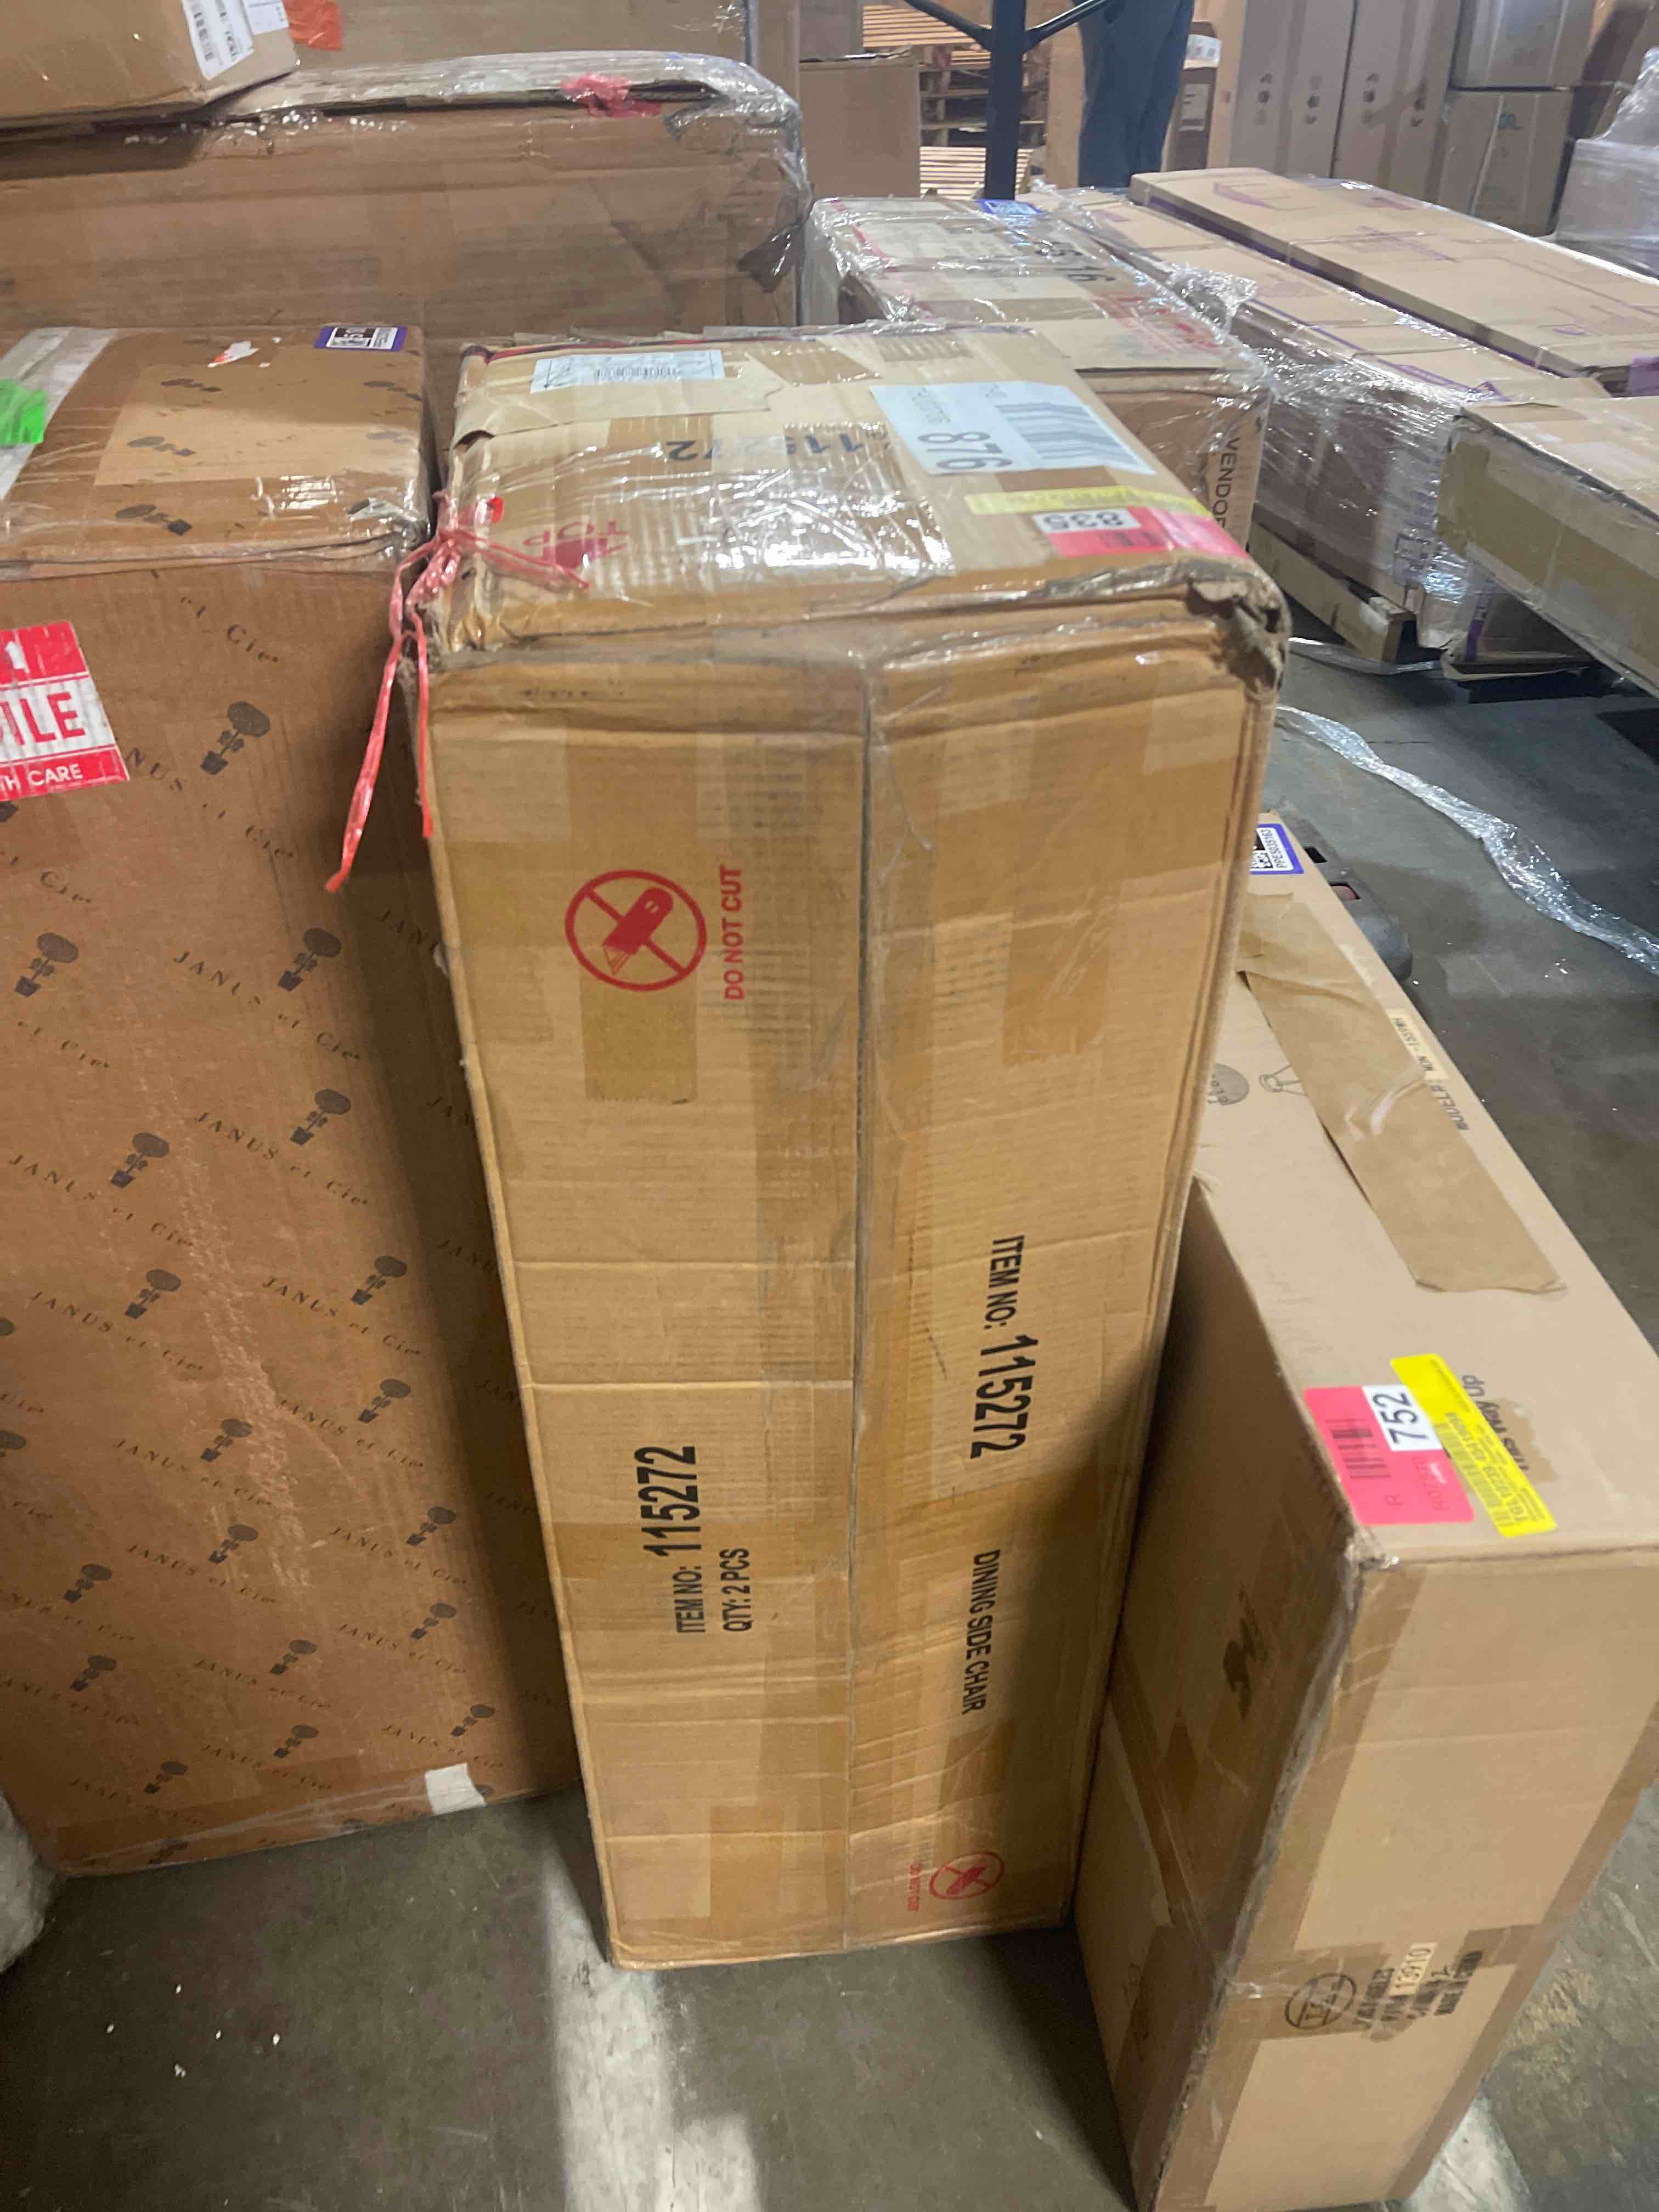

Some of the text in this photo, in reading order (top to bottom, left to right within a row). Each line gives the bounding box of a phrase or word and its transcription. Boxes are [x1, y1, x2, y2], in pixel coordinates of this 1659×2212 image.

[0, 692, 86, 746] ILE
[27, 764, 83, 787] CARE
[719, 863, 745, 1001] DO NOT CUT
[970, 1235, 1038, 1459] ITEM NO: 115272
[1373, 1392, 1429, 1444] 752
[634, 1446, 706, 1633] ITEM NO: 115272
[719, 1548, 753, 1632] QTY: 2 PCS
[961, 1549, 1000, 1715] DINING SIDE CHAIR
